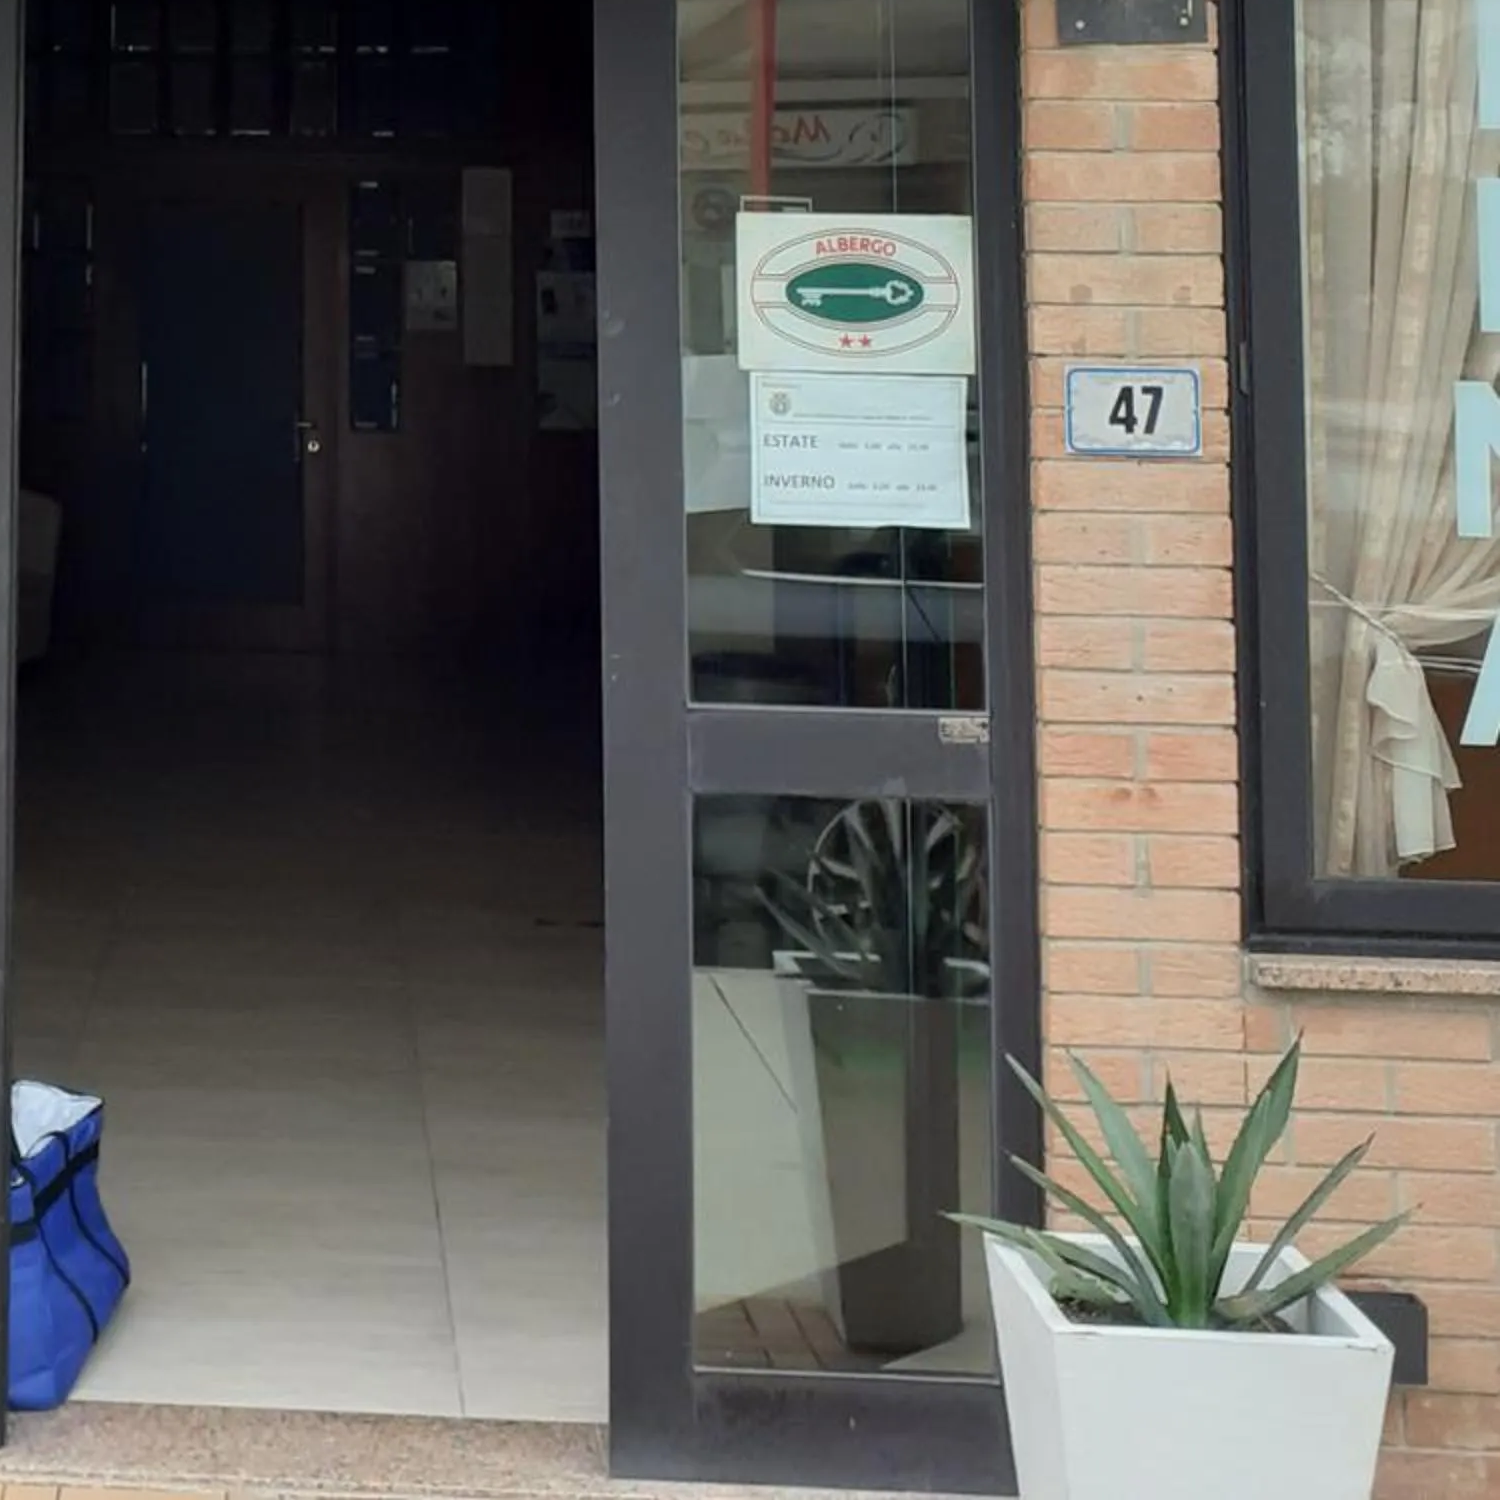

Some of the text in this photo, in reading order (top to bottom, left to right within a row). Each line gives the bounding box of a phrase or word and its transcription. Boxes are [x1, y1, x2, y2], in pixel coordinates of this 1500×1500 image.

[815, 235, 897, 257] ALBERGO
[1108, 386, 1164, 435] 47
[763, 434, 819, 450] ESTATE
[764, 474, 836, 491] INVERNO
